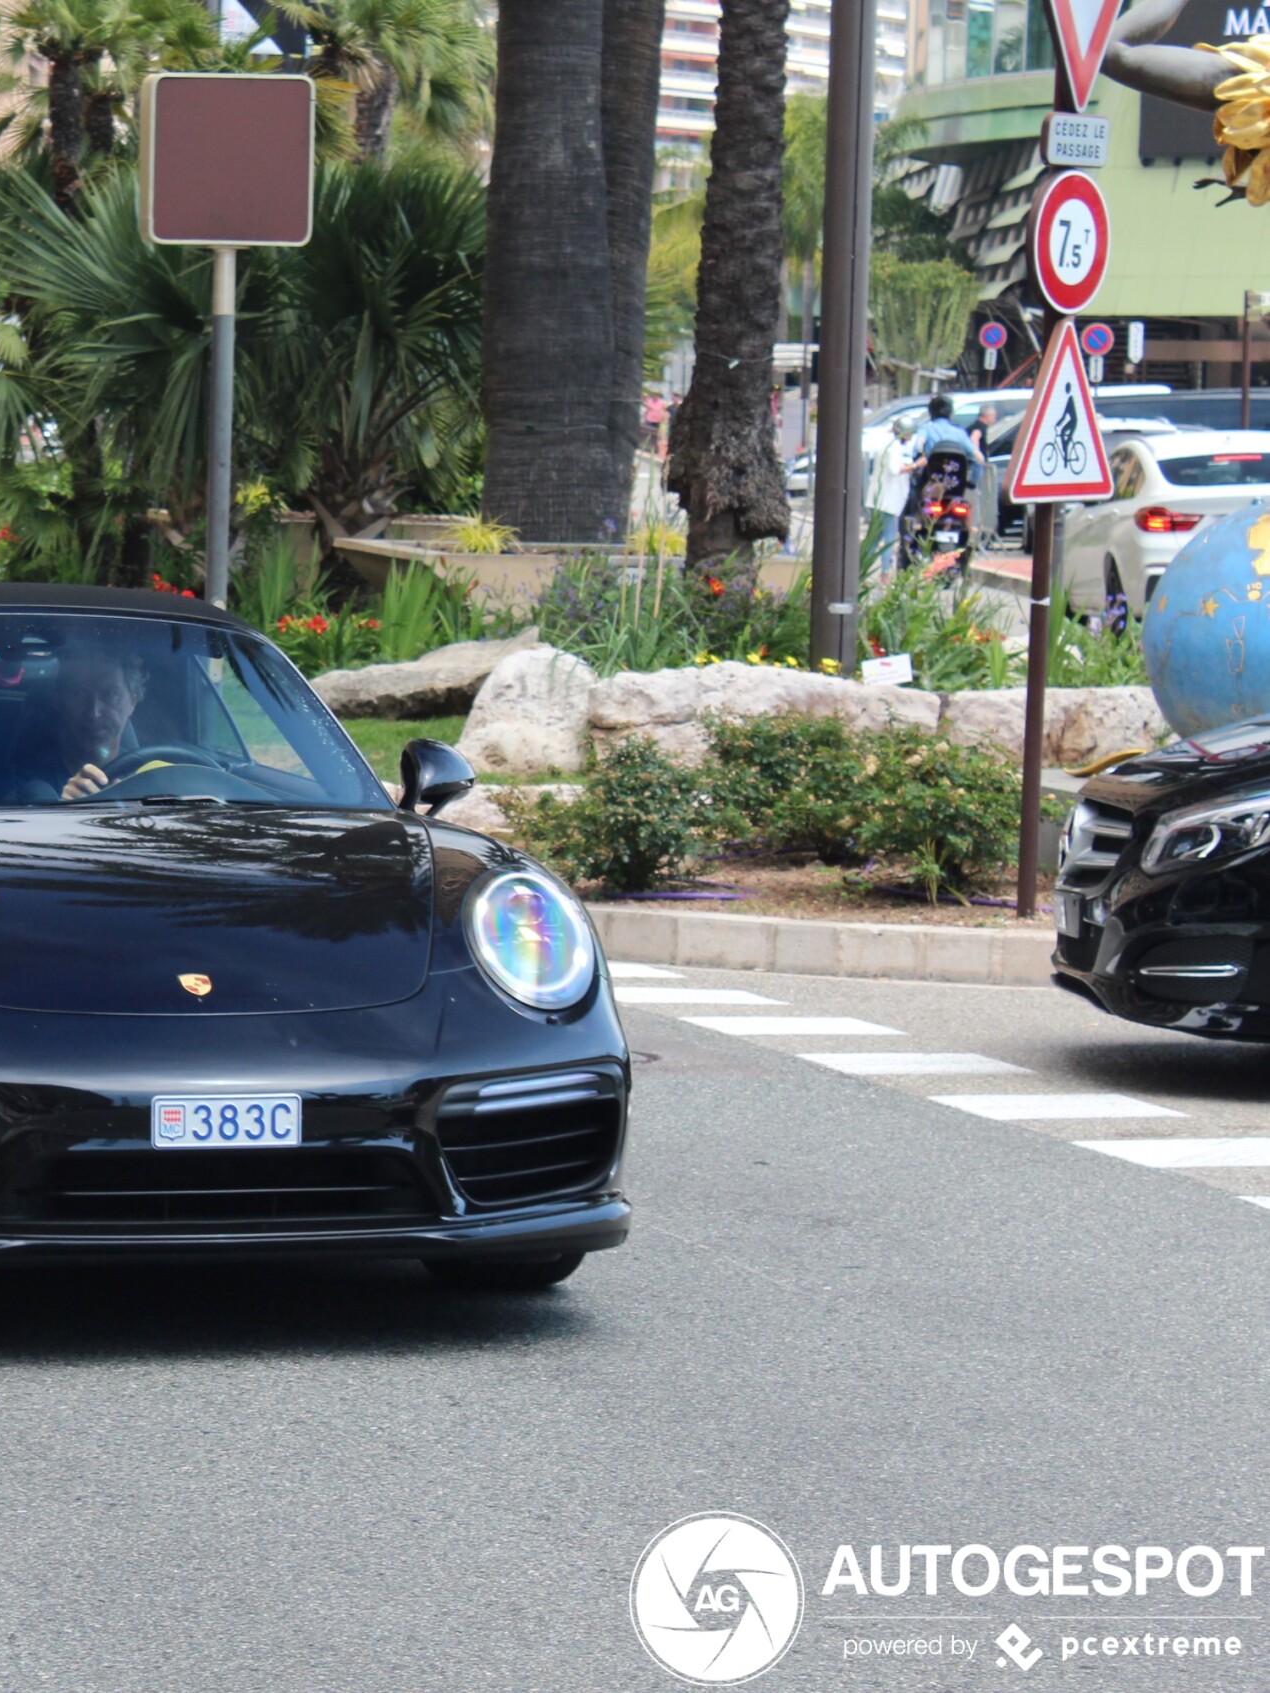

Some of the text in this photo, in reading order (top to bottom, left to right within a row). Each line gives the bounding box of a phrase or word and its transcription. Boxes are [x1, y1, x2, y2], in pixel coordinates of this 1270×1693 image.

[1055, 118, 1105, 139] CÉDEZ LE
[1056, 142, 1101, 159] PASSAGE
[192, 1102, 292, 1141] 383C
